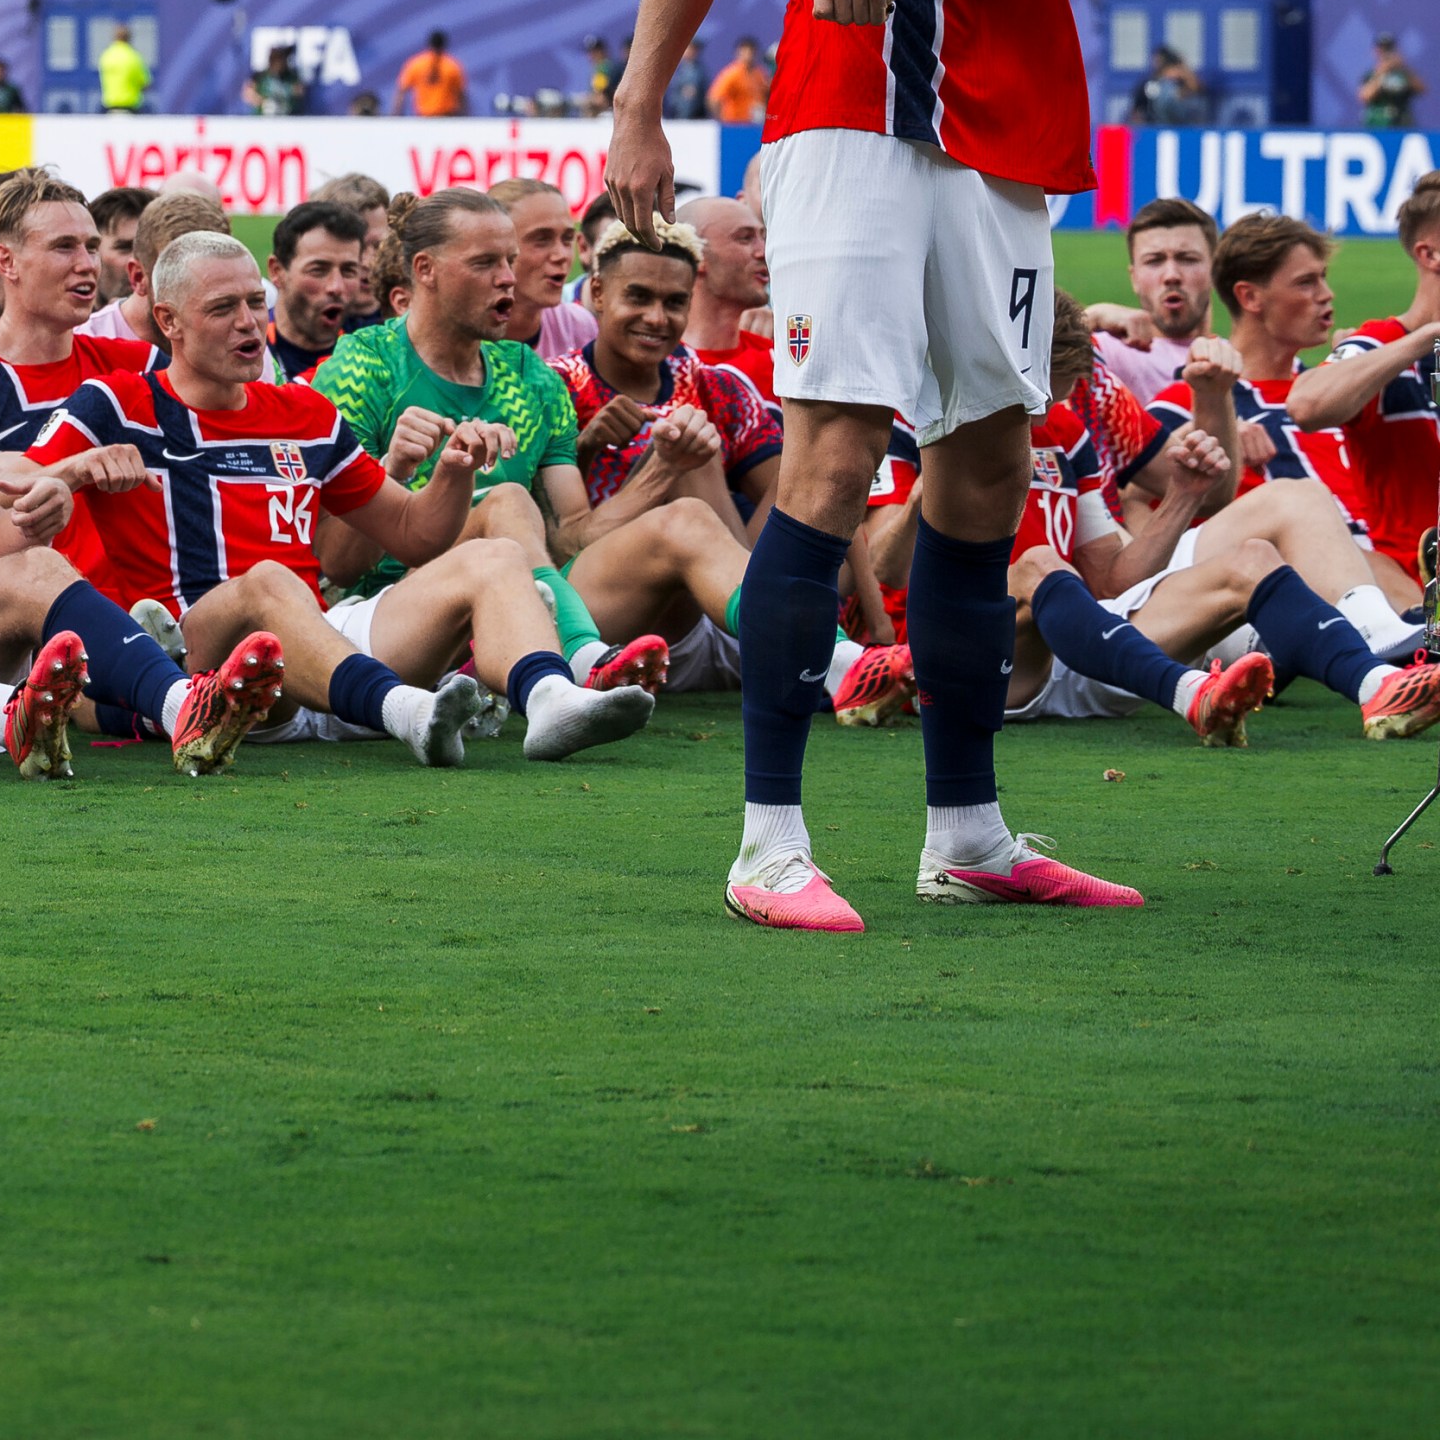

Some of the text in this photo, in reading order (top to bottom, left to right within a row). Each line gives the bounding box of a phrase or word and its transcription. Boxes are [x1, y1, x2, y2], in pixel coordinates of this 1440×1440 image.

[1155, 130, 1440, 234] ULTRA
[1009, 267, 1038, 349] 9
[265, 483, 315, 545] 26
[1037, 491, 1073, 556] 10
